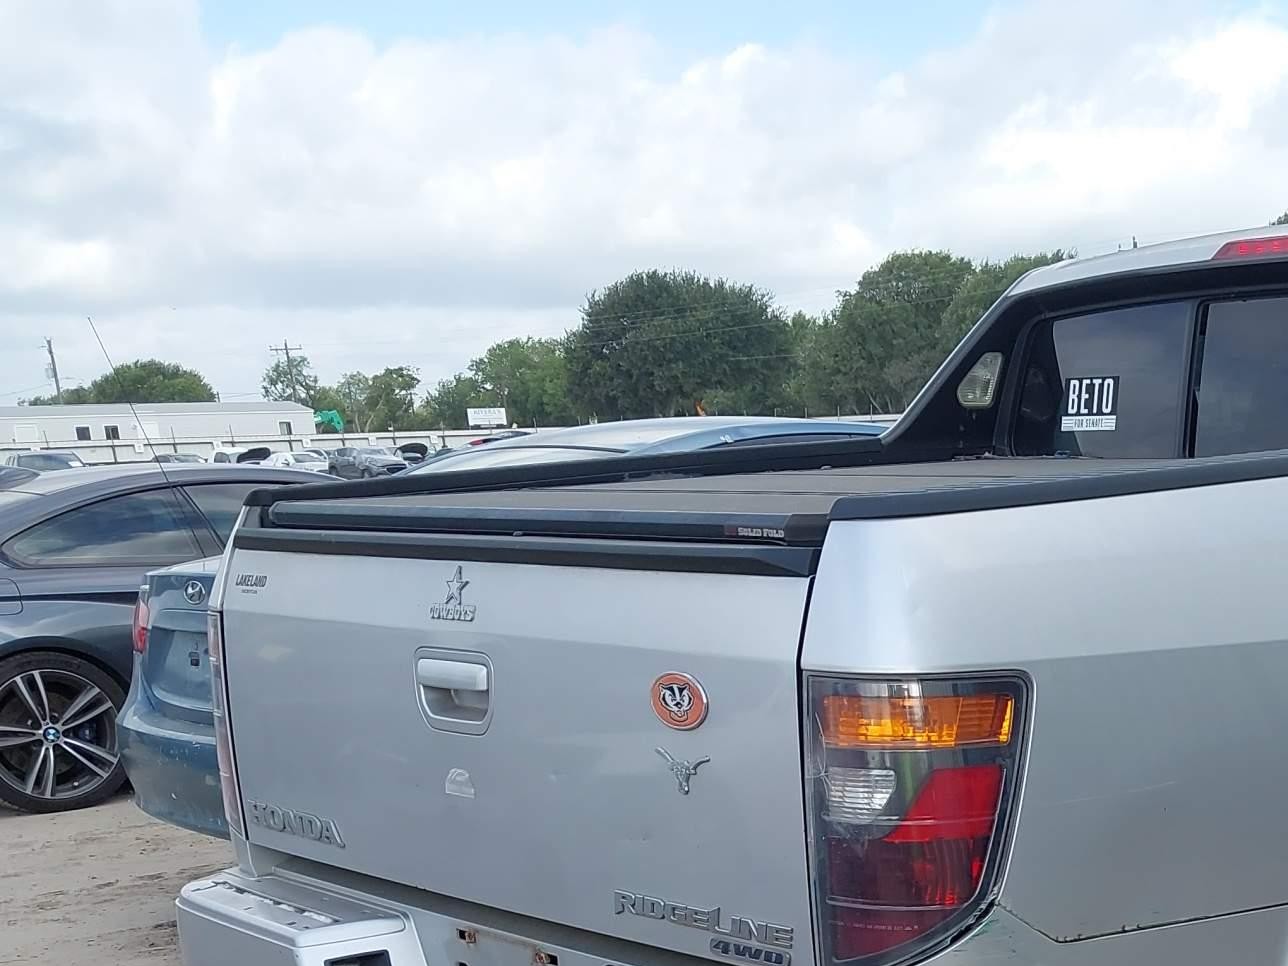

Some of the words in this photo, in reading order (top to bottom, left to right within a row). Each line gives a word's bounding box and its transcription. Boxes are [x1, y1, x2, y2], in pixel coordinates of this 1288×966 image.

[1067, 378, 1114, 414] BETO
[1074, 418, 1084, 428] FOR
[1085, 417, 1104, 428] SENATE
[737, 527, 762, 537] SOLID
[763, 528, 785, 538] FOLD
[235, 573, 268, 588] LAKELAND
[429, 603, 477, 622] COWBOYS
[247, 799, 346, 849] HONDA
[614, 889, 794, 949] RIDGELINE
